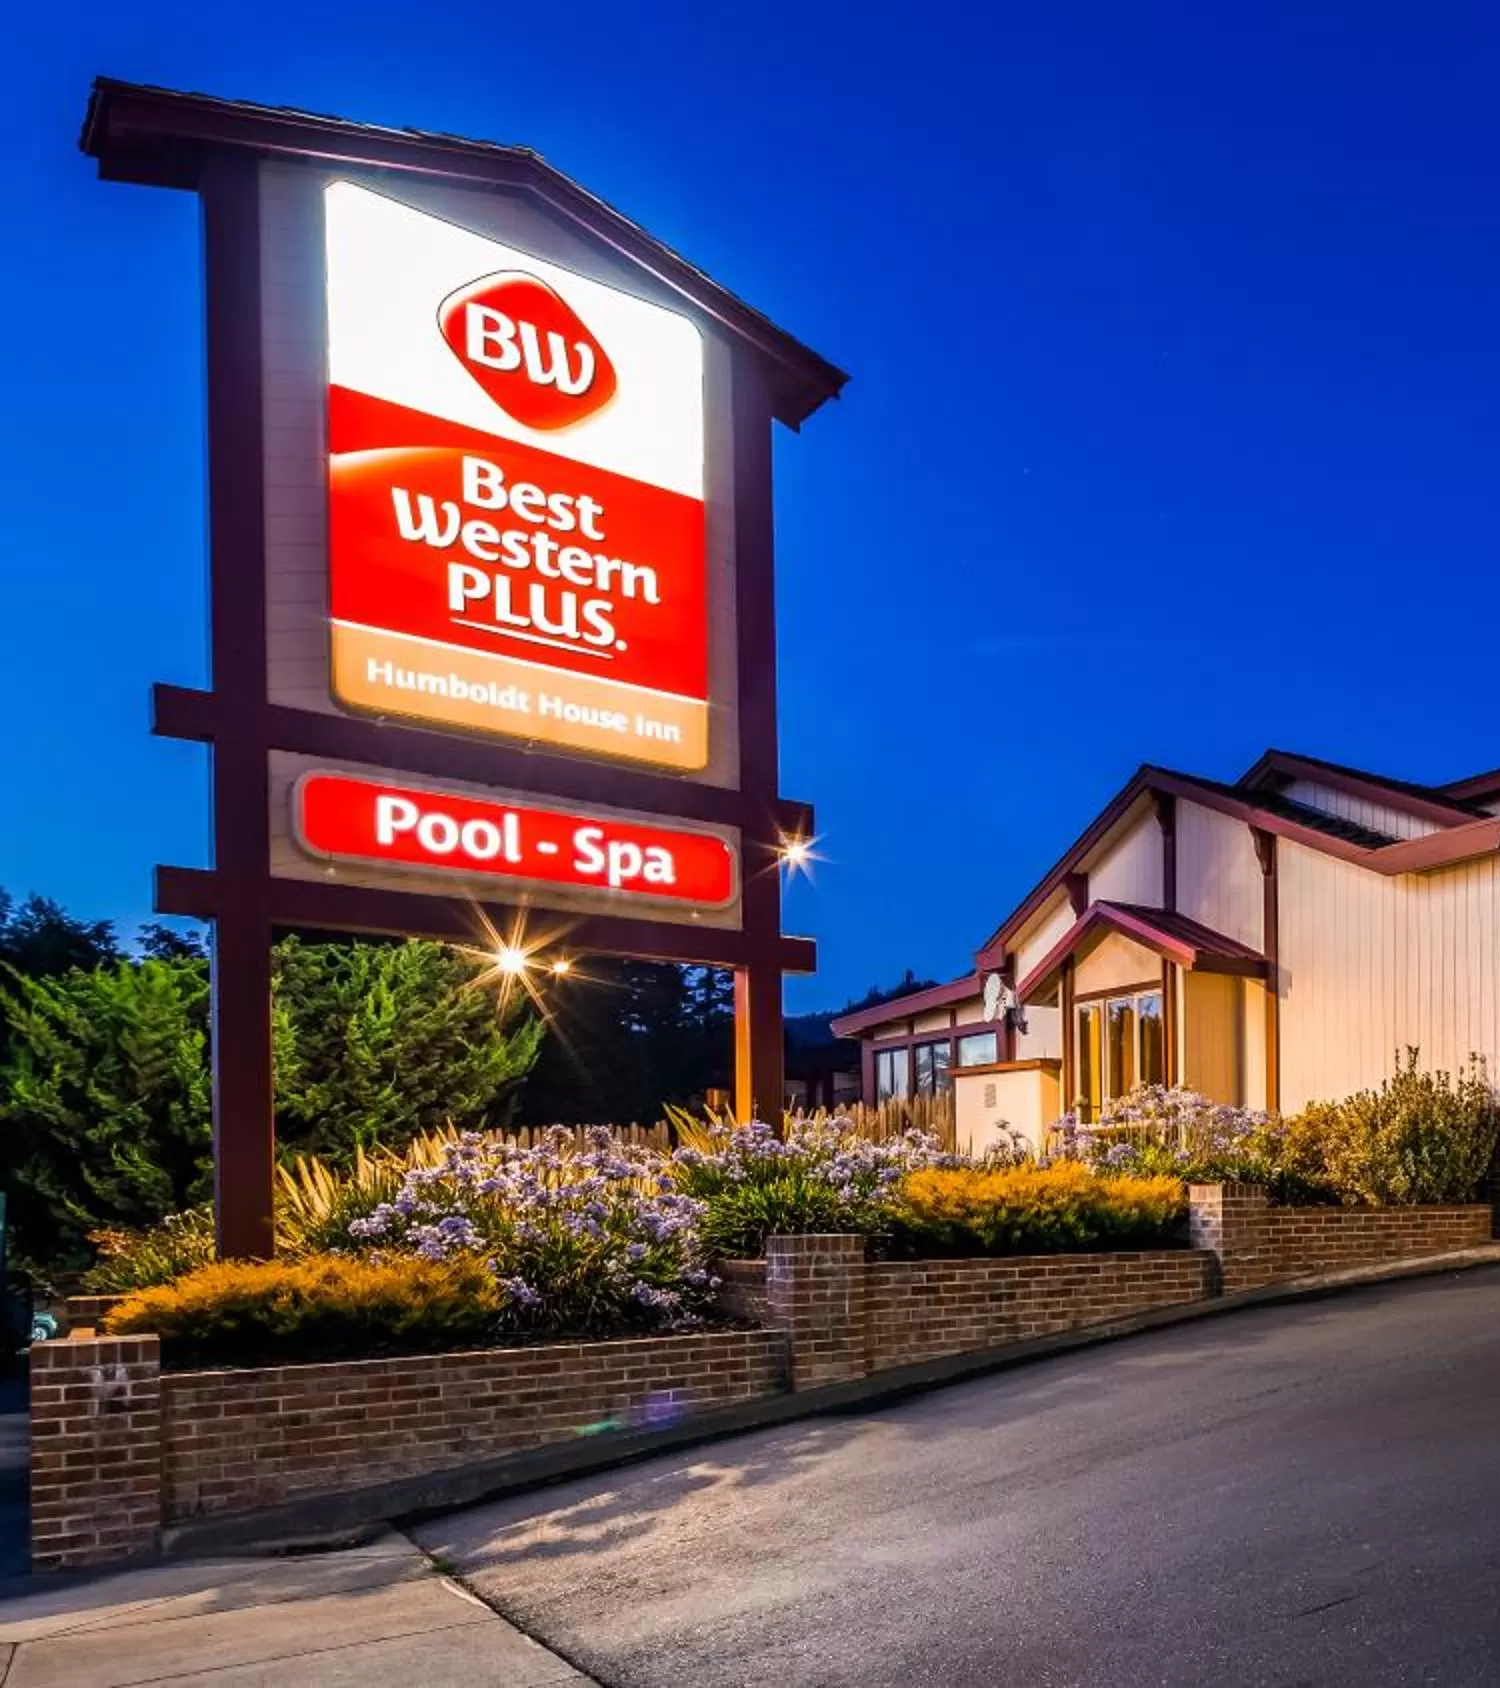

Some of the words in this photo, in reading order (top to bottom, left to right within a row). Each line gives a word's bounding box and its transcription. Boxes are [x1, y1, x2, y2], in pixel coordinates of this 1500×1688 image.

[464, 302, 595, 395] BW
[461, 455, 604, 540] Best
[391, 487, 661, 604] Western
[366, 657, 530, 713] Humboldt
[538, 694, 627, 733] House
[635, 714, 681, 744] Inn
[375, 796, 521, 863] Pool
[573, 827, 677, 887] Spa
